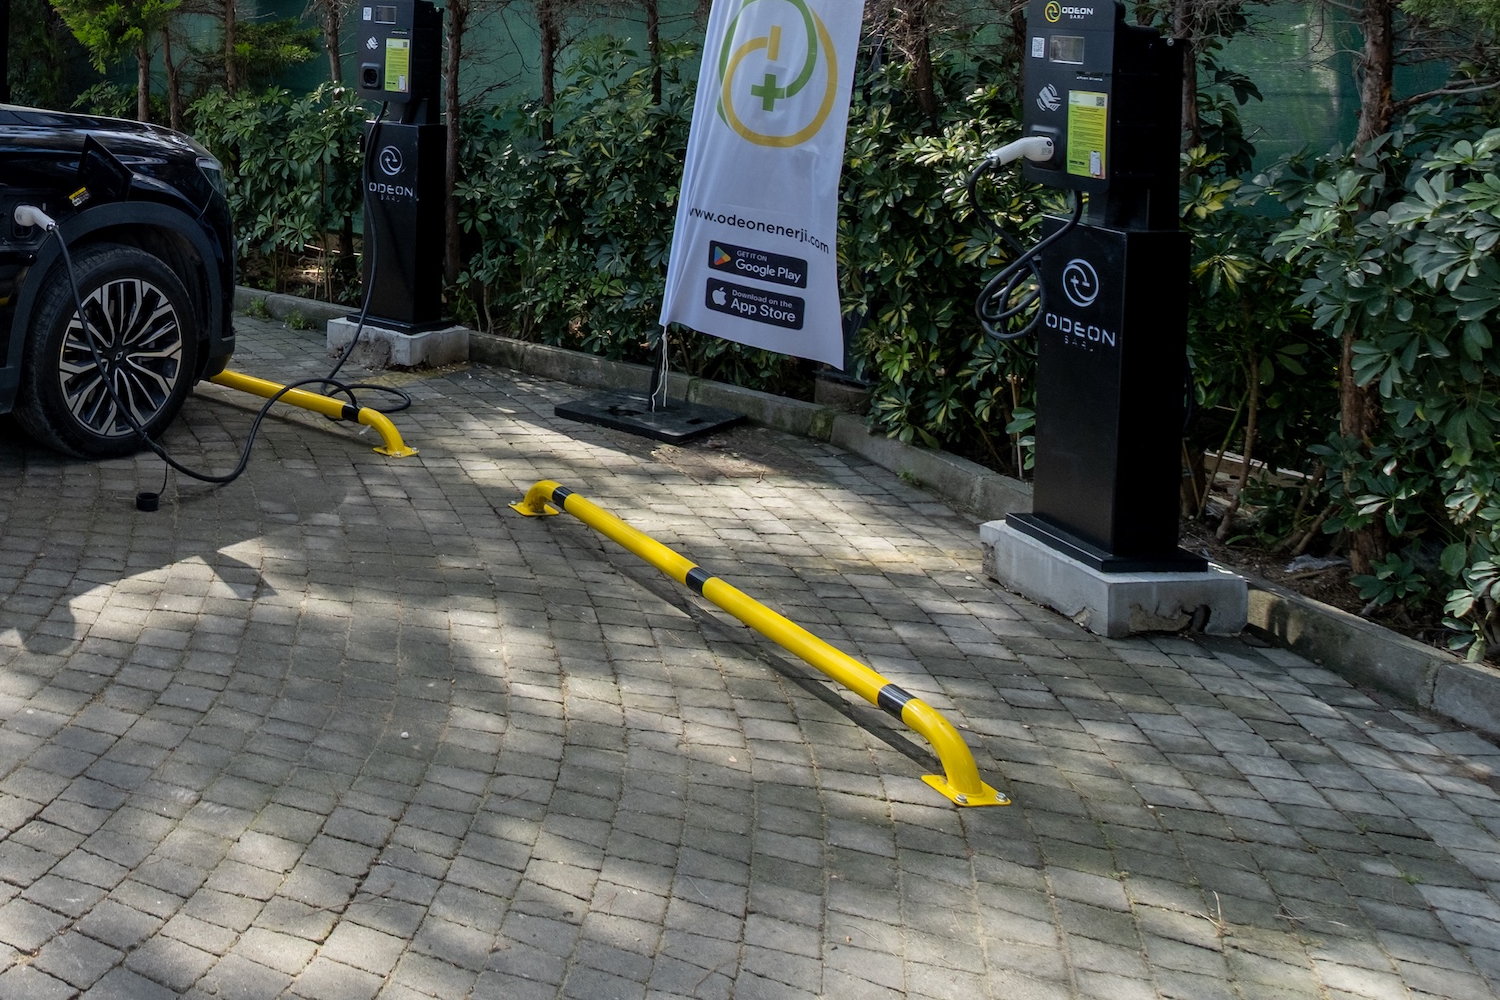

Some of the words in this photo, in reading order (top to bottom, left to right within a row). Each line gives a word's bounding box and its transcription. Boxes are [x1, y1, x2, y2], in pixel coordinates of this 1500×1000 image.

[1061, 6, 1094, 15] ODEON
[368, 181, 414, 197] ODEON
[689, 207, 830, 254] ww.odeonenerji.com
[736, 250, 749, 258] GET
[757, 254, 767, 262] ON
[735, 258, 776, 277] Google
[777, 266, 802, 283] Play
[731, 289, 767, 303] Download
[779, 299, 793, 308] the
[730, 298, 757, 315] App
[759, 305, 796, 323] Store
[1045, 312, 1116, 347] ODEON
